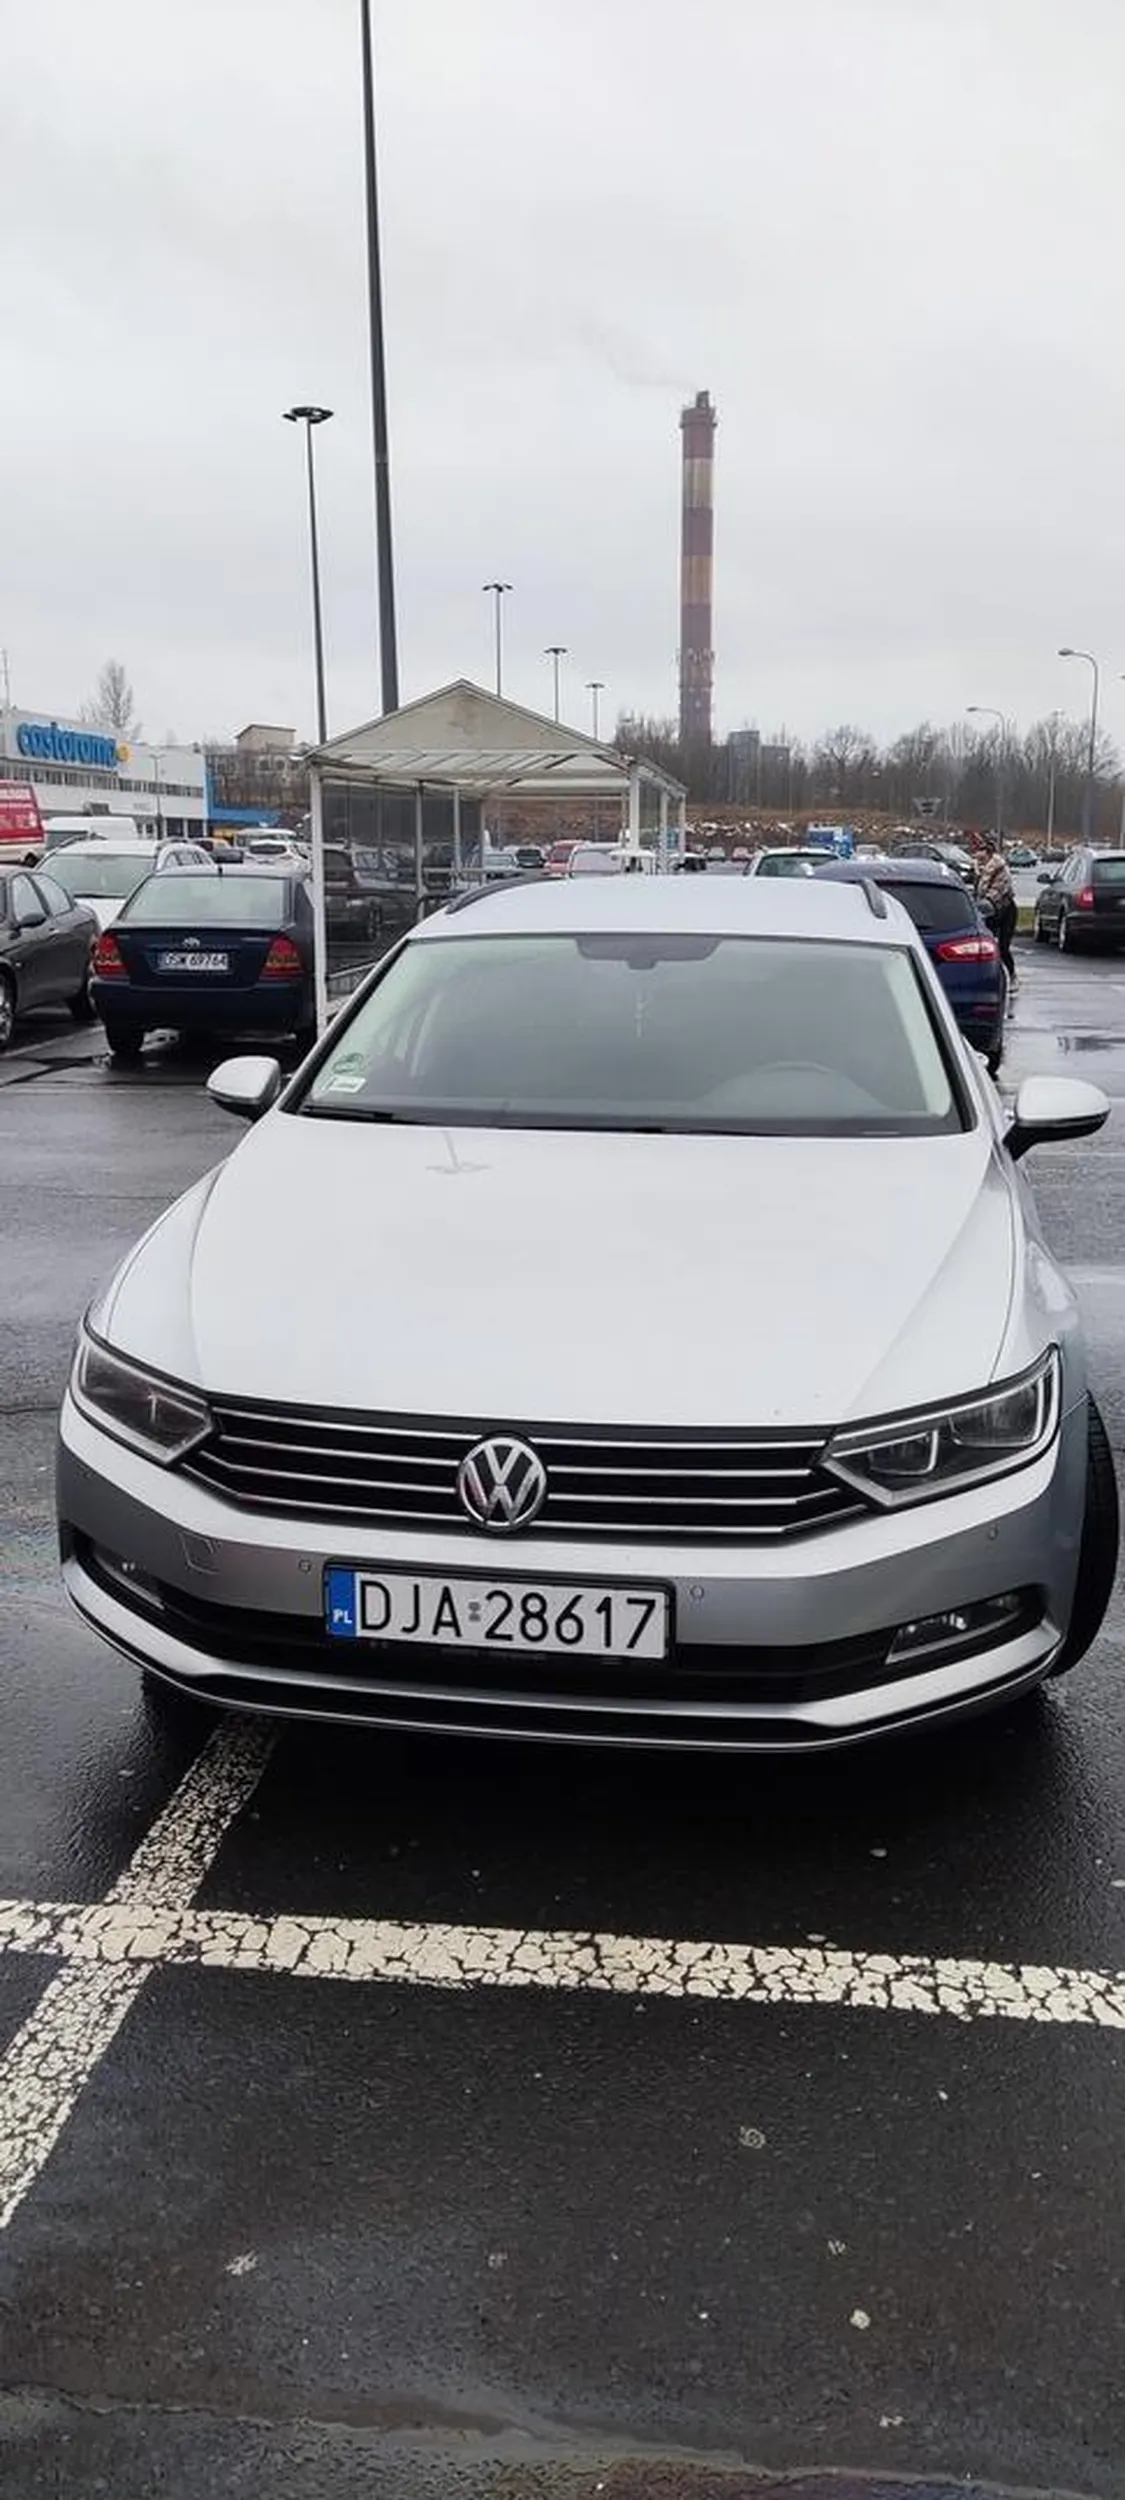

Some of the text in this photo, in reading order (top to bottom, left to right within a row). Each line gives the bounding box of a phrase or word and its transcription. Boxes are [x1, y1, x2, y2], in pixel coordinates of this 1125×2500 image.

[16, 722, 118, 767] castorama
[332, 1608, 353, 1624] PL
[359, 1579, 657, 1650] DJA 28617
